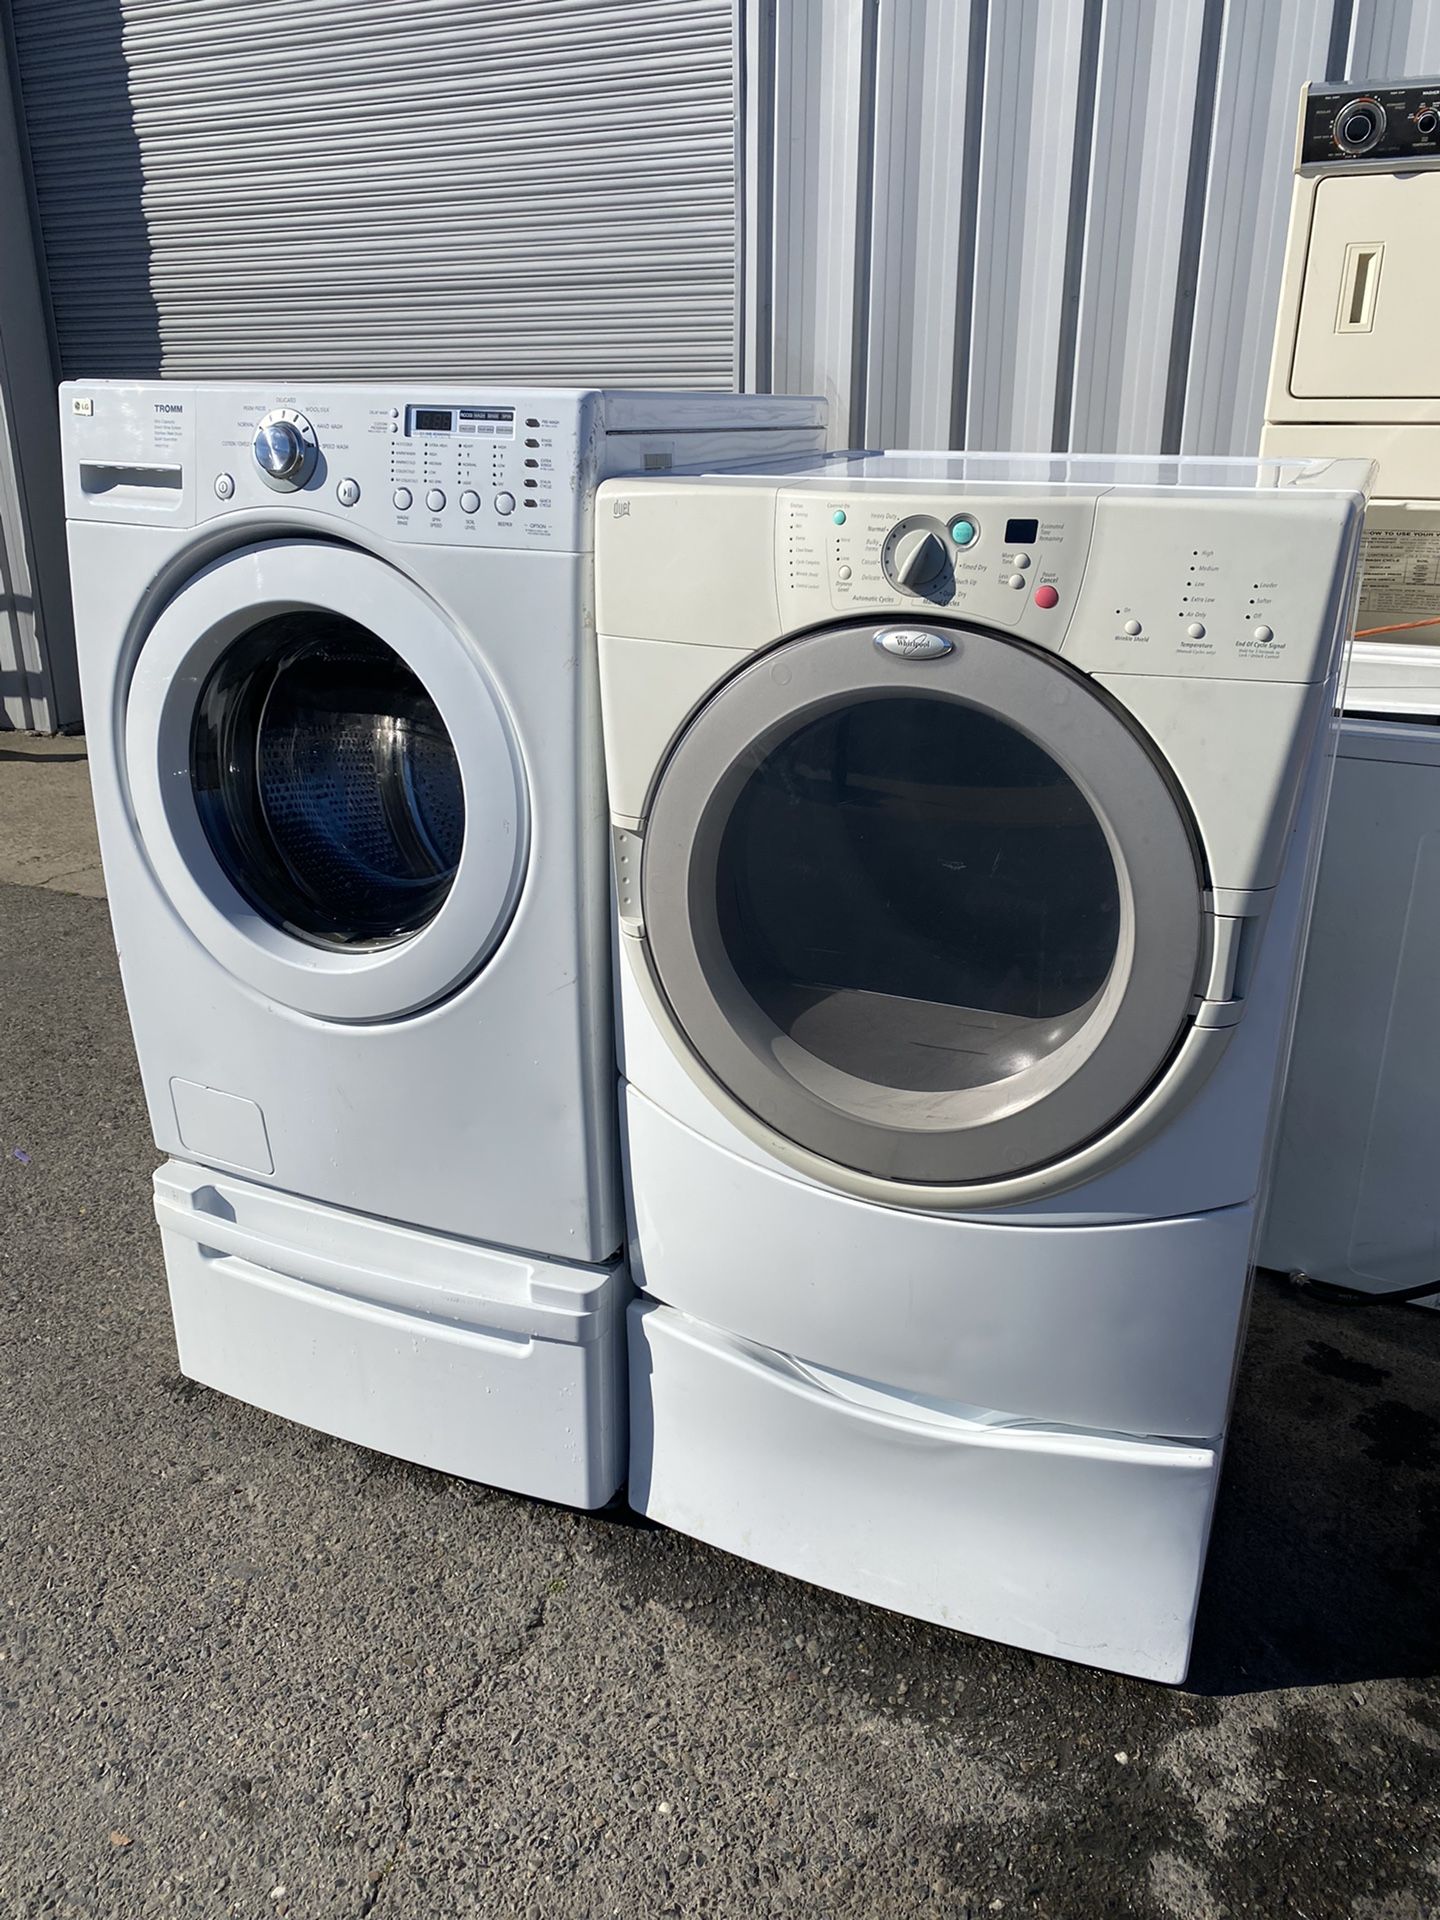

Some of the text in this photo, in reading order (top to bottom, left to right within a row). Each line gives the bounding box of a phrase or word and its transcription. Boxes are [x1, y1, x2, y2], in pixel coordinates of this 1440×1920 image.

[154, 404, 183, 413] TROMM
[613, 499, 631, 518] duet
[978, 563, 987, 572] Dry
[879, 595, 894, 603] Cycles
[897, 639, 930, 648] Whirlpool
